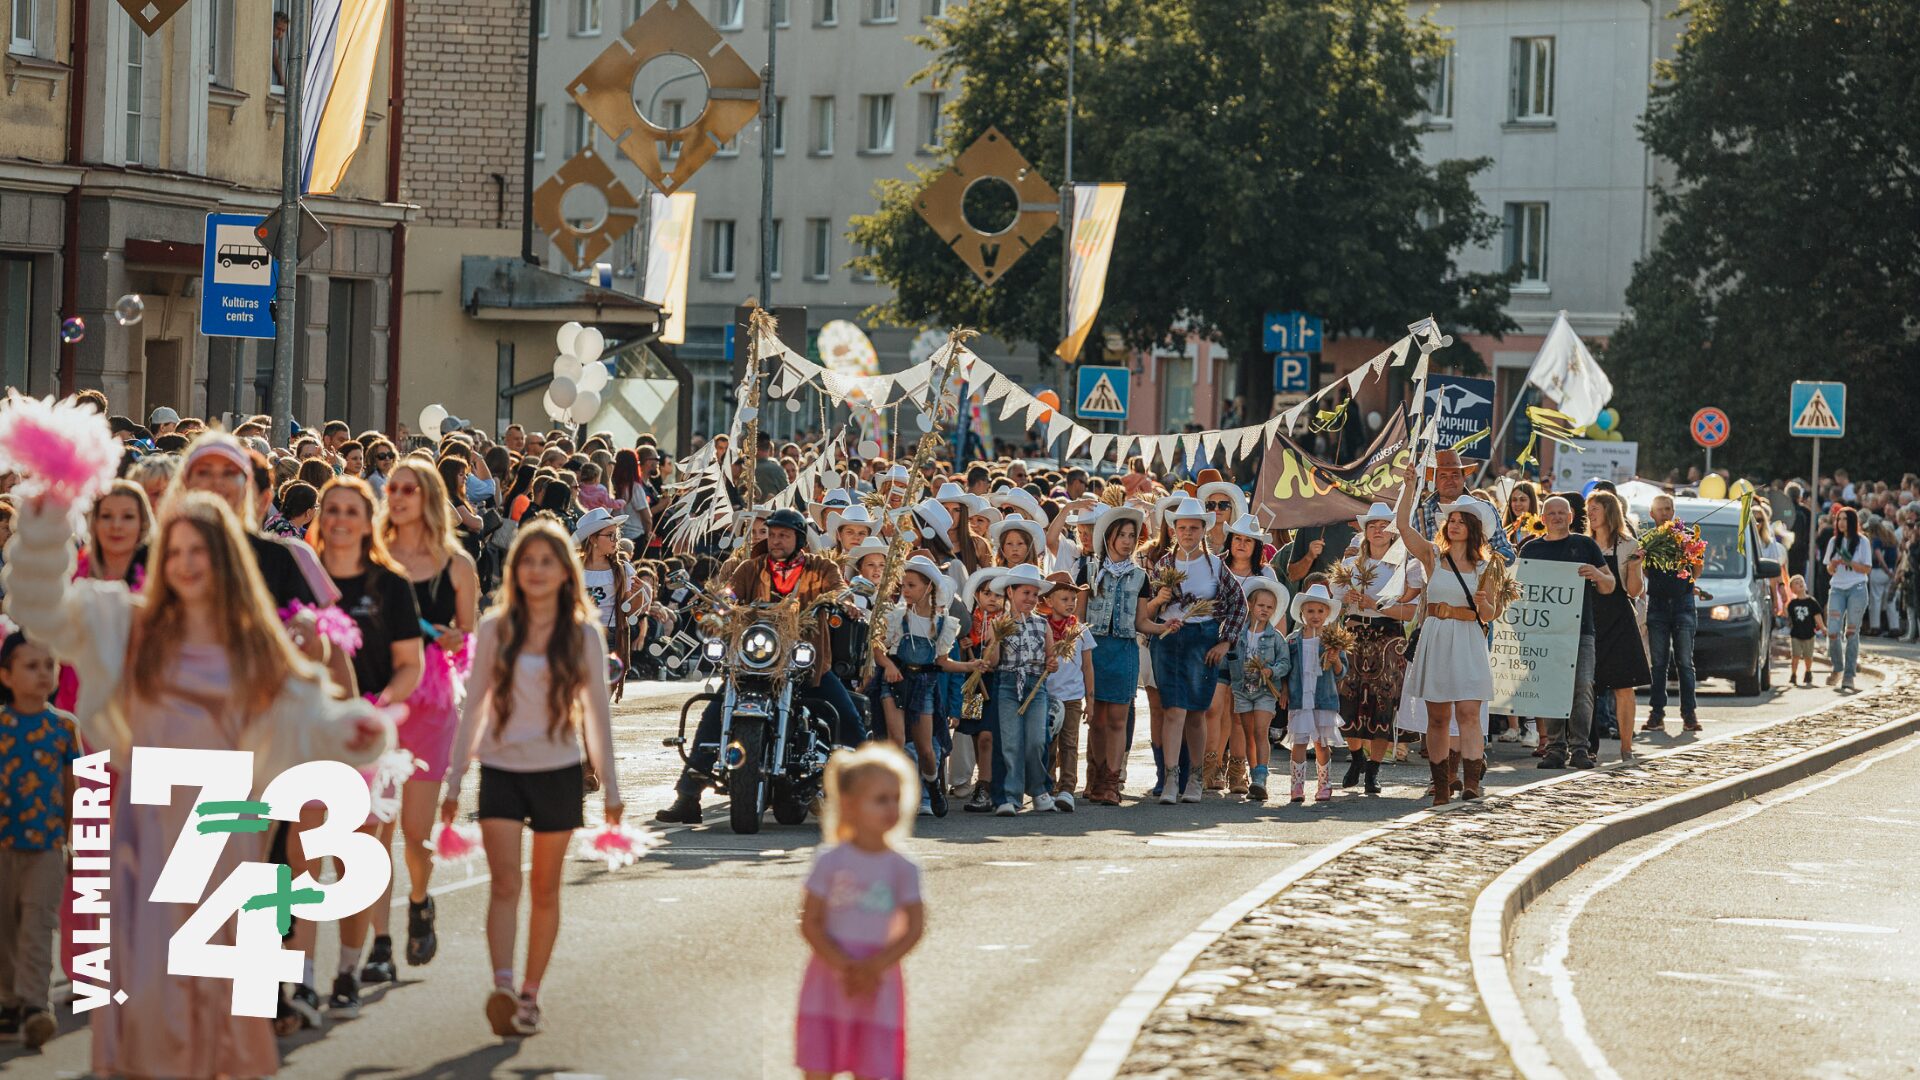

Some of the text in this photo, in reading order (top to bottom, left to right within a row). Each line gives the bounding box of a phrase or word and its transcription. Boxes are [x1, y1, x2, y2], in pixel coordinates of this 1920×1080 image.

[222, 296, 259, 309] Kultūras
[226, 311, 254, 322] centrs
[1281, 359, 1302, 388] P
[1425, 414, 1480, 433] CMPHILL
[1519, 583, 1576, 605] IEKU
[1500, 607, 1550, 628] GUS
[1494, 631, 1527, 642] ATRU
[1494, 644, 1549, 658] RTDIENU
[1509, 659, 1537, 671] 18:30
[1495, 672, 1508, 680] TAS
